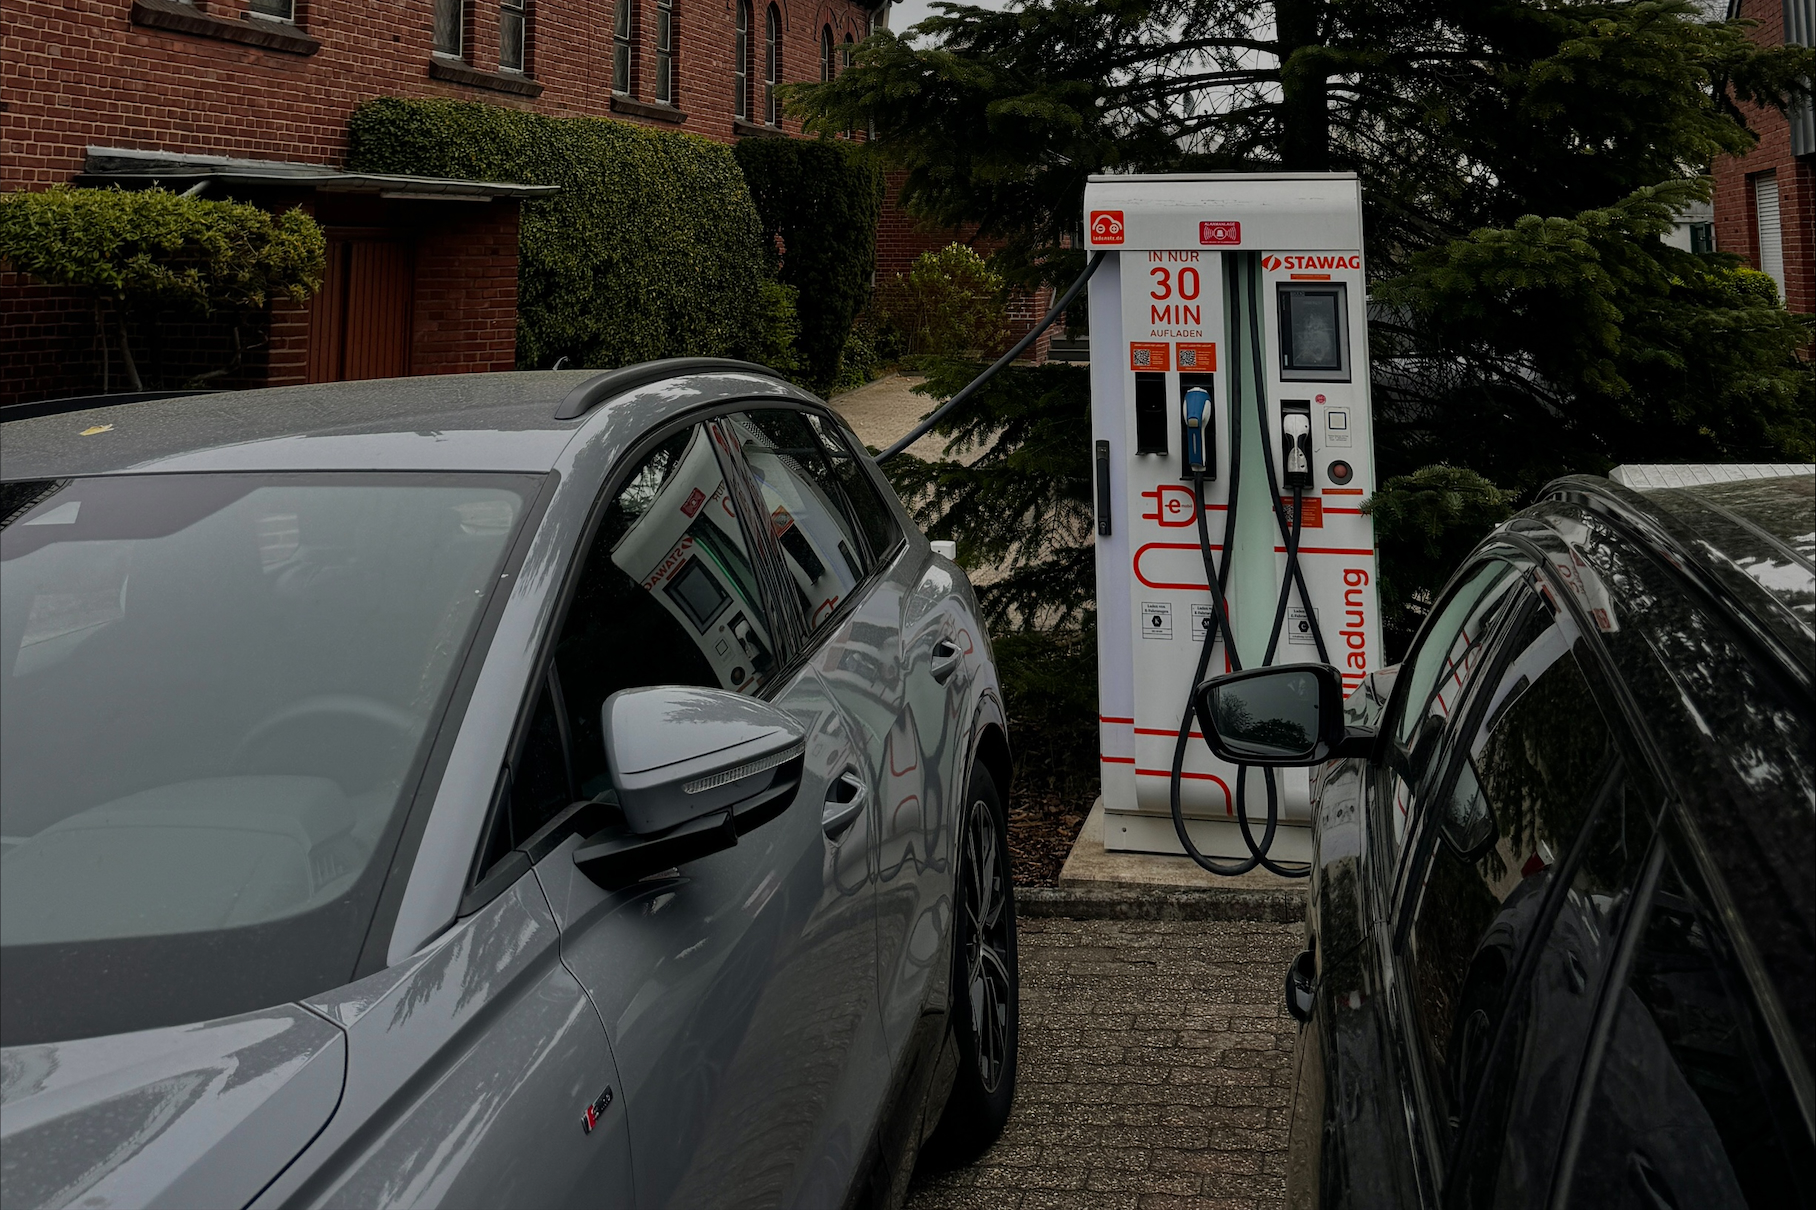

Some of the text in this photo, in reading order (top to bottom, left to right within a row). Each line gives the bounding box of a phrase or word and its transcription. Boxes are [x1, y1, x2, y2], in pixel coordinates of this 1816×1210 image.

[1148, 250, 1200, 262] IN NUR
[1284, 255, 1360, 270] STAWAG
[1150, 267, 1200, 300] 30
[1151, 304, 1201, 325] MIN
[1150, 329, 1203, 338] AUFLADEN
